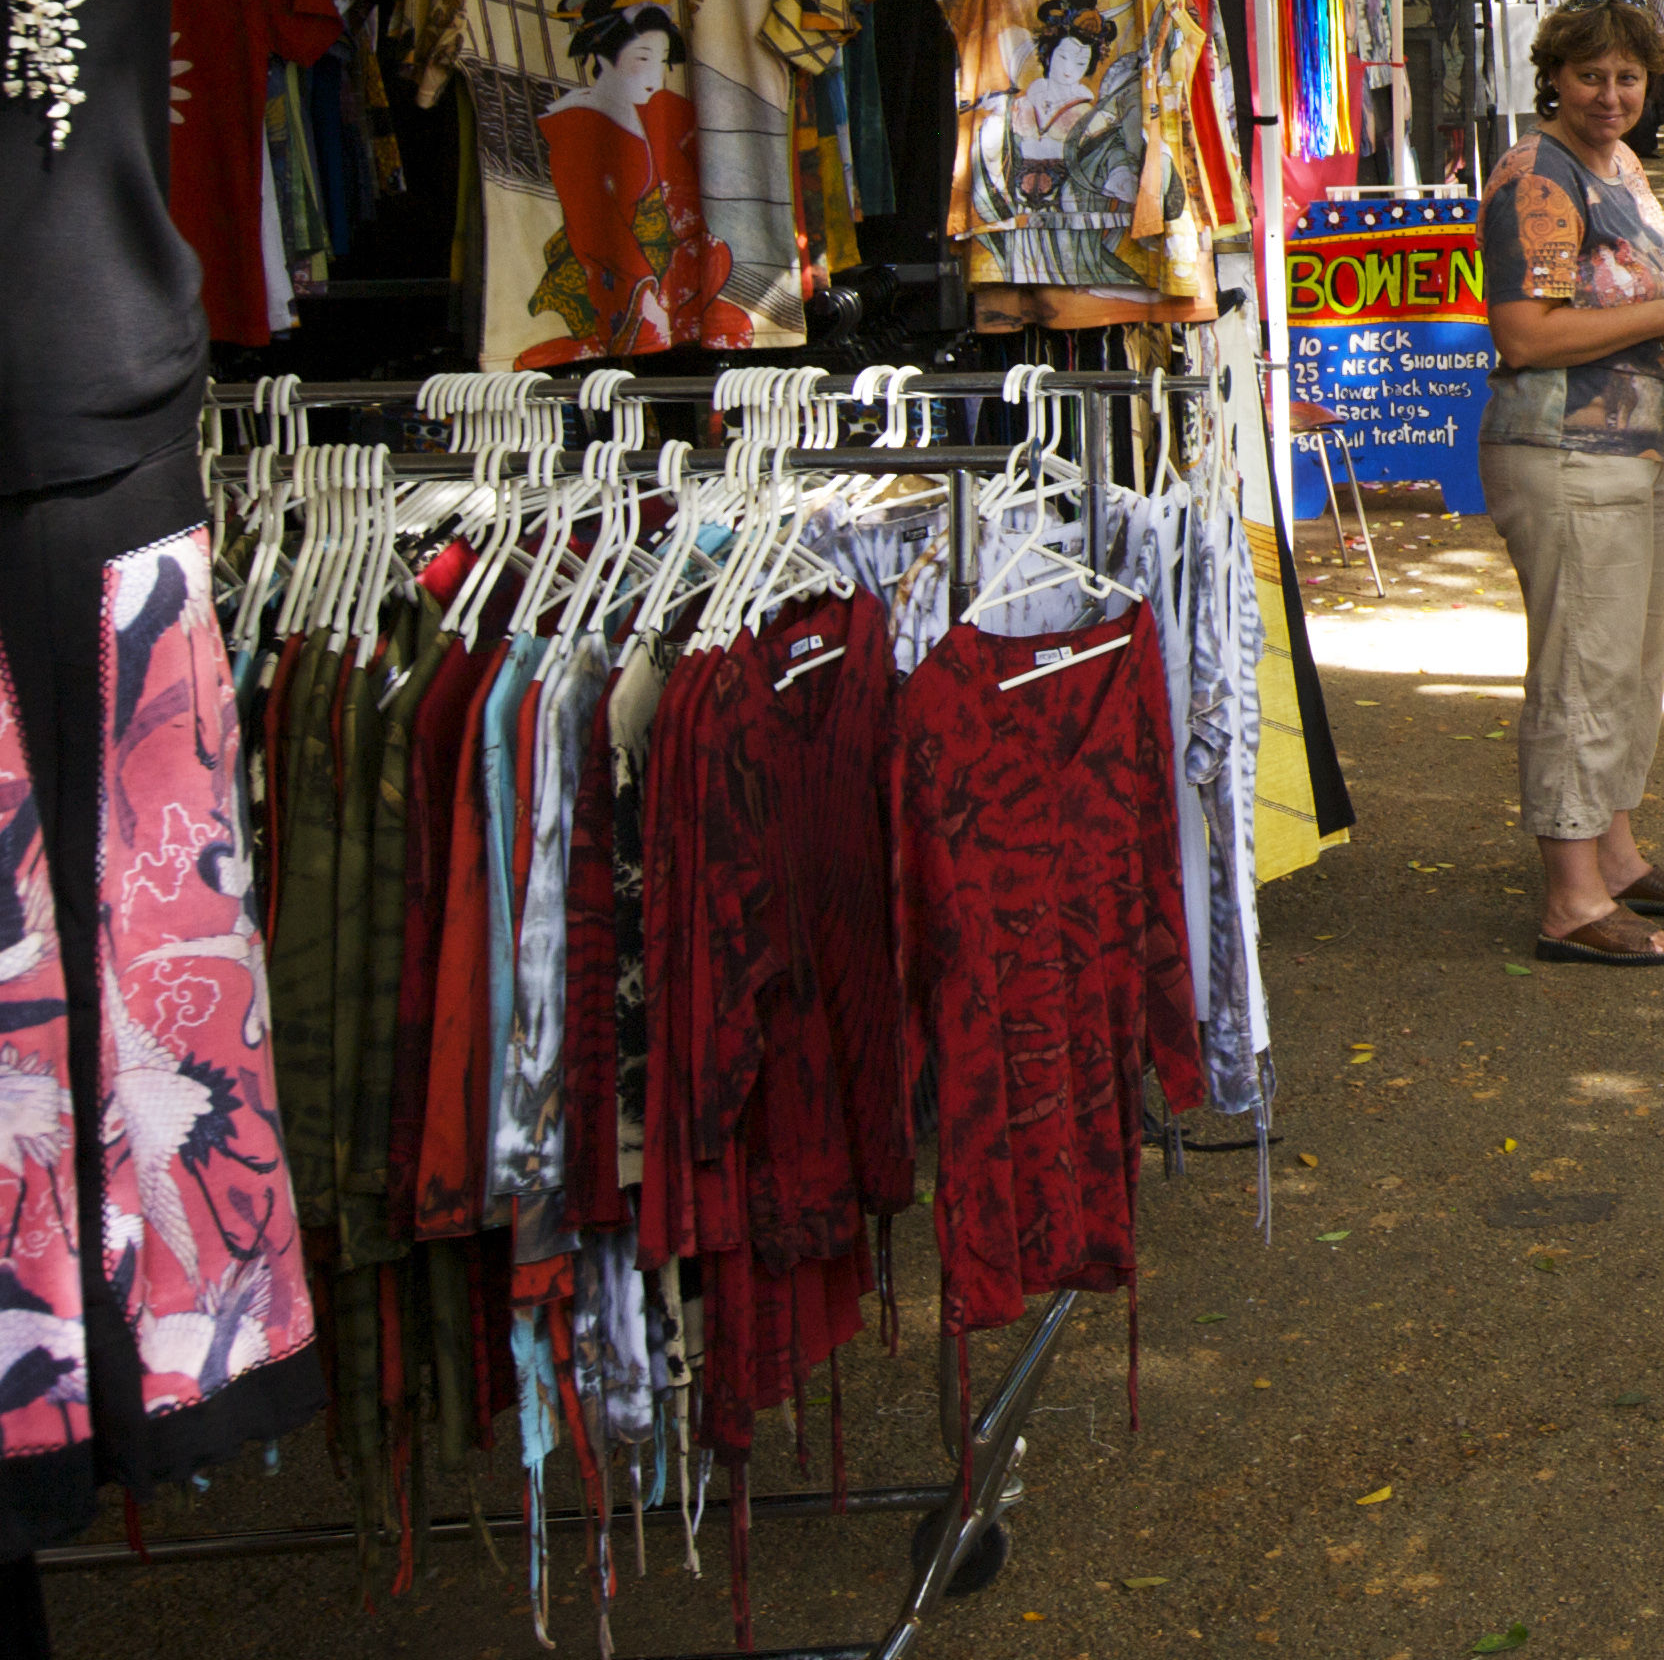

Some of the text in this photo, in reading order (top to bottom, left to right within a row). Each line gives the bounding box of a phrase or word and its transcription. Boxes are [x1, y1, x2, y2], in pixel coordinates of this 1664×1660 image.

[1286, 248, 1485, 315] BOWEN
[1299, 336, 1322, 356] 10
[1349, 329, 1412, 354] NECK
[1294, 361, 1319, 383] 25
[1341, 356, 1394, 376] NECK
[1400, 351, 1489, 372] SHOULDER
[1381, 378, 1422, 398] back
[1390, 401, 1430, 422] legs
[1372, 415, 1459, 448] treatment
